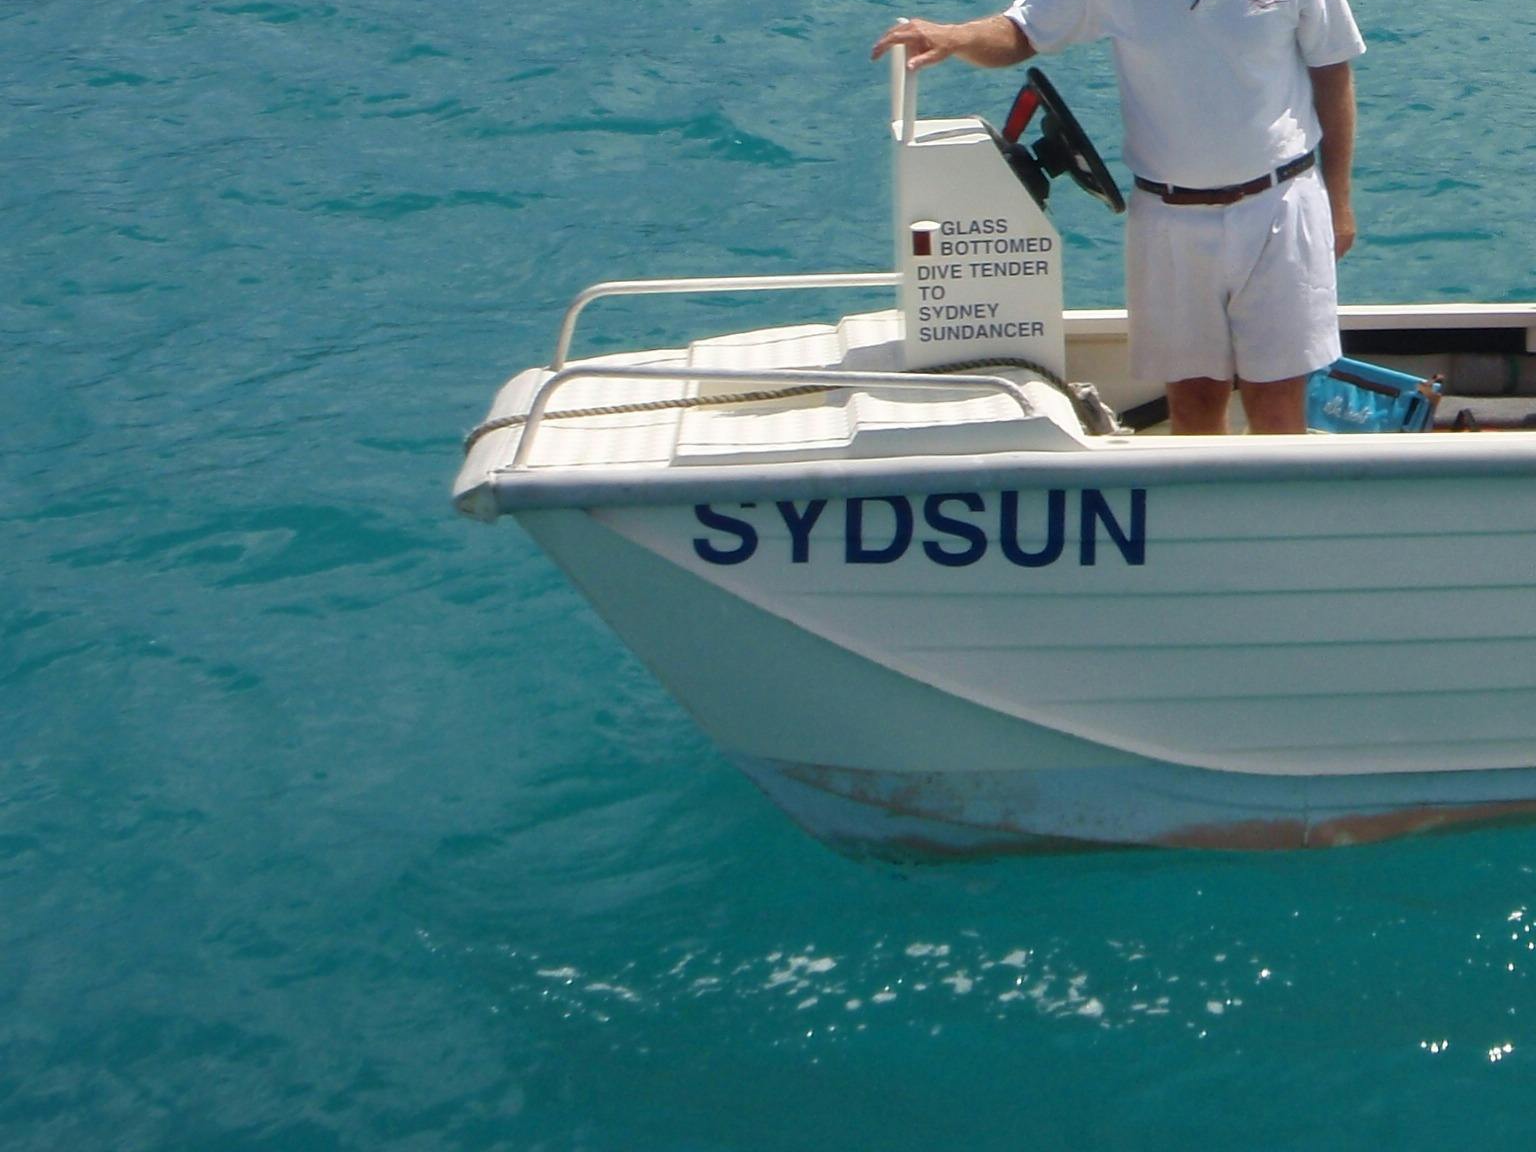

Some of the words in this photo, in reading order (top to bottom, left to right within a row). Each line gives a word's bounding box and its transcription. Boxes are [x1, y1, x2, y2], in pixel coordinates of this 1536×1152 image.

[940, 219, 1008, 236] GLASS
[940, 237, 1052, 256] BOTTOMED
[917, 264, 962, 281] DIVE
[969, 261, 1049, 279] TENDER
[918, 285, 946, 301] TO
[919, 303, 999, 322] SYDNEY
[919, 321, 1044, 343] SUNDANCER
[692, 489, 1147, 568] SYDSUN
